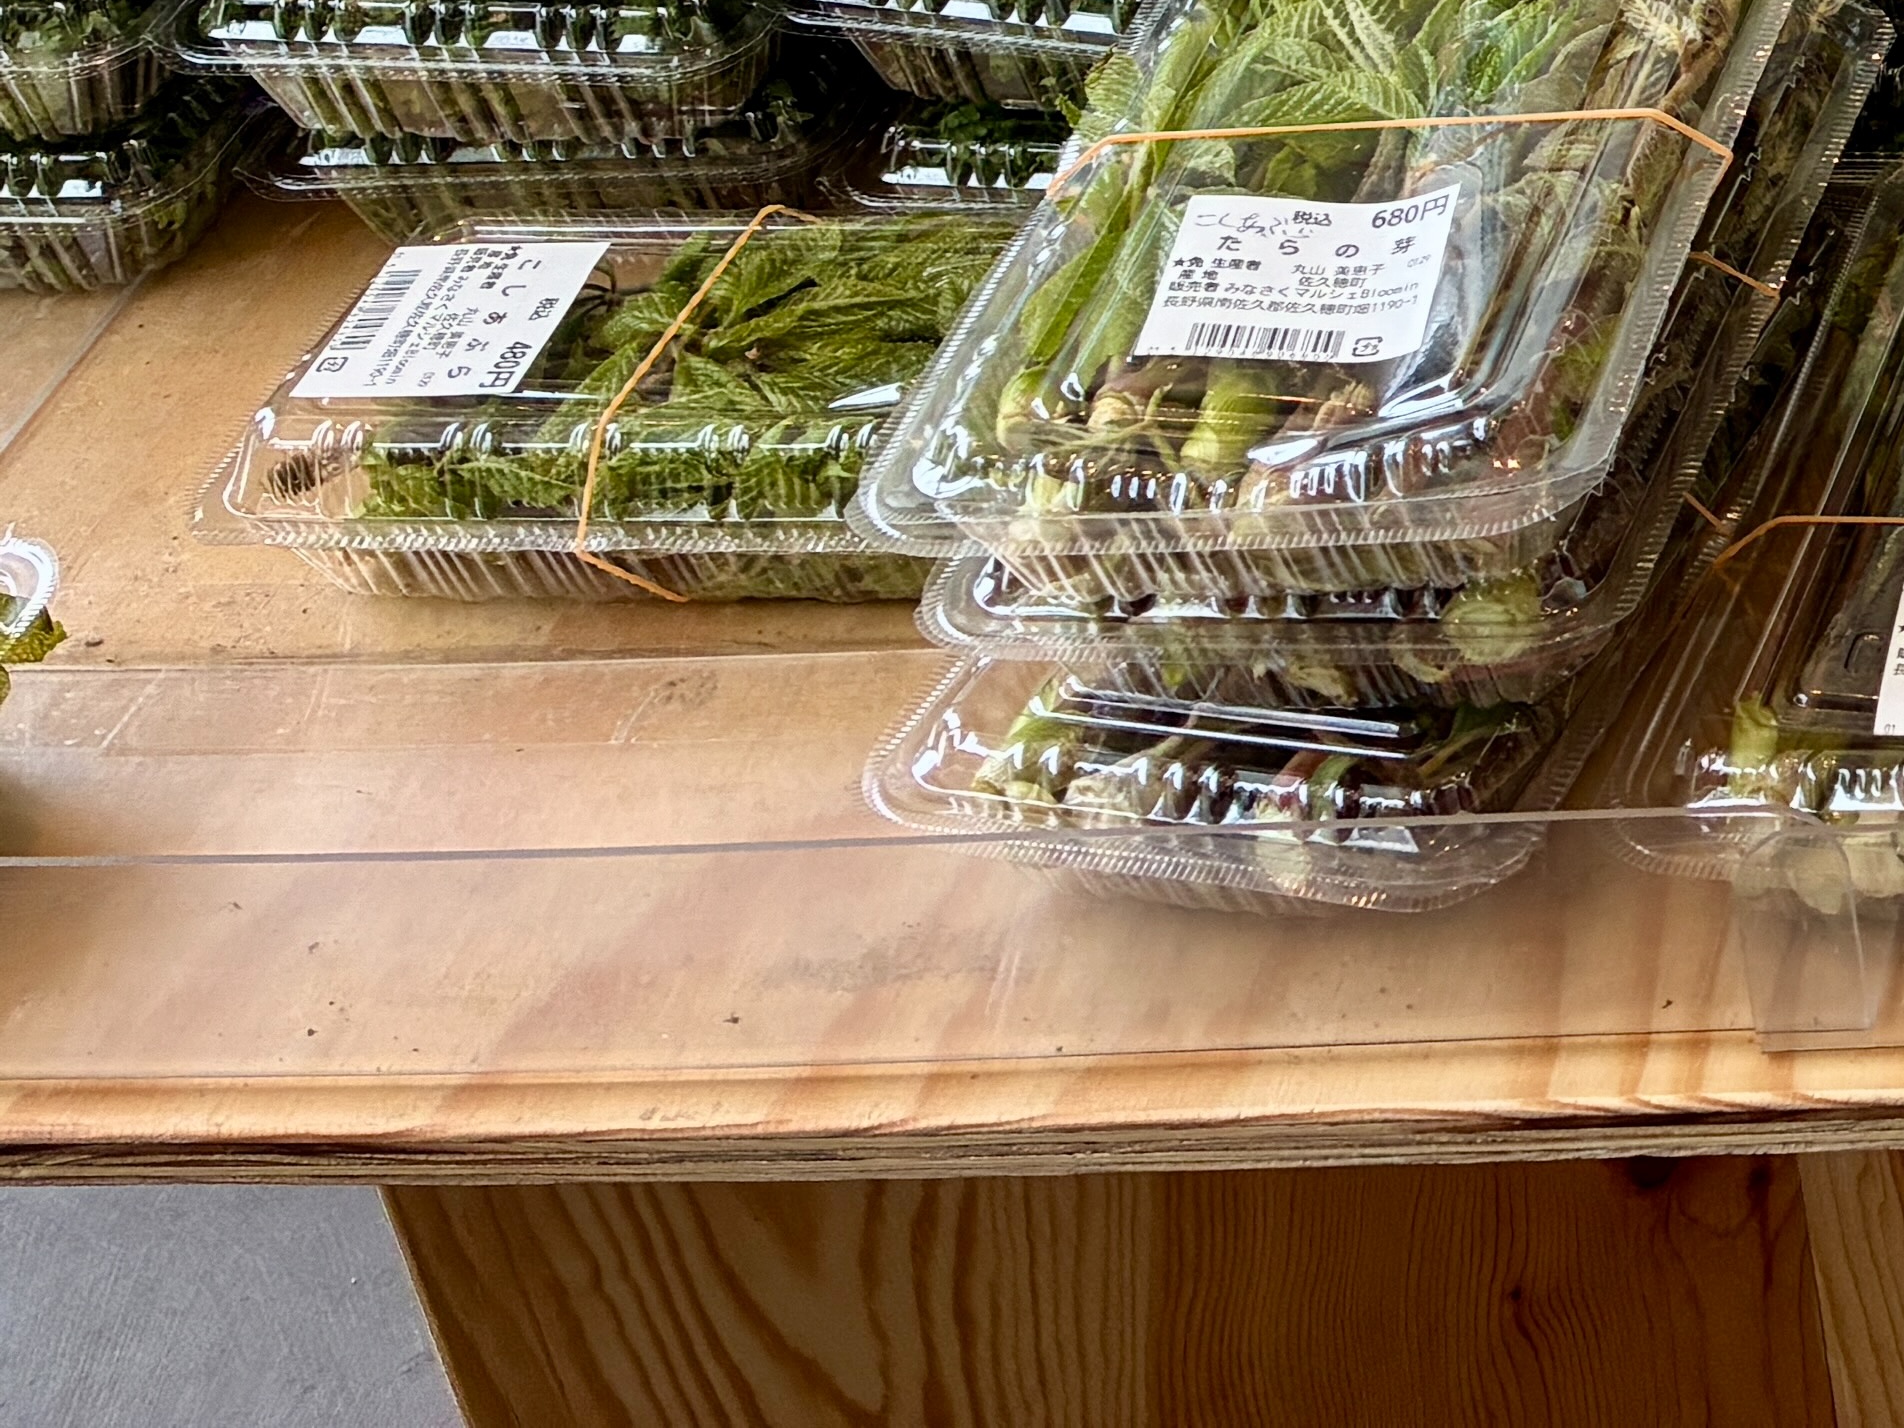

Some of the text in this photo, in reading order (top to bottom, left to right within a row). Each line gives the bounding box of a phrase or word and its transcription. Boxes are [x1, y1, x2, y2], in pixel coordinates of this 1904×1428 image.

[1293, 194, 1449, 230] 税込 680円
[1216, 235, 1416, 258] たらの芽
[1212, 257, 1262, 271] 生産者
[1292, 263, 1325, 276] 丸山
[1224, 281, 1419, 300] みなさくマルシェBloomin
[1298, 276, 1366, 288] 佐久穂町
[479, 341, 534, 390] 480円
